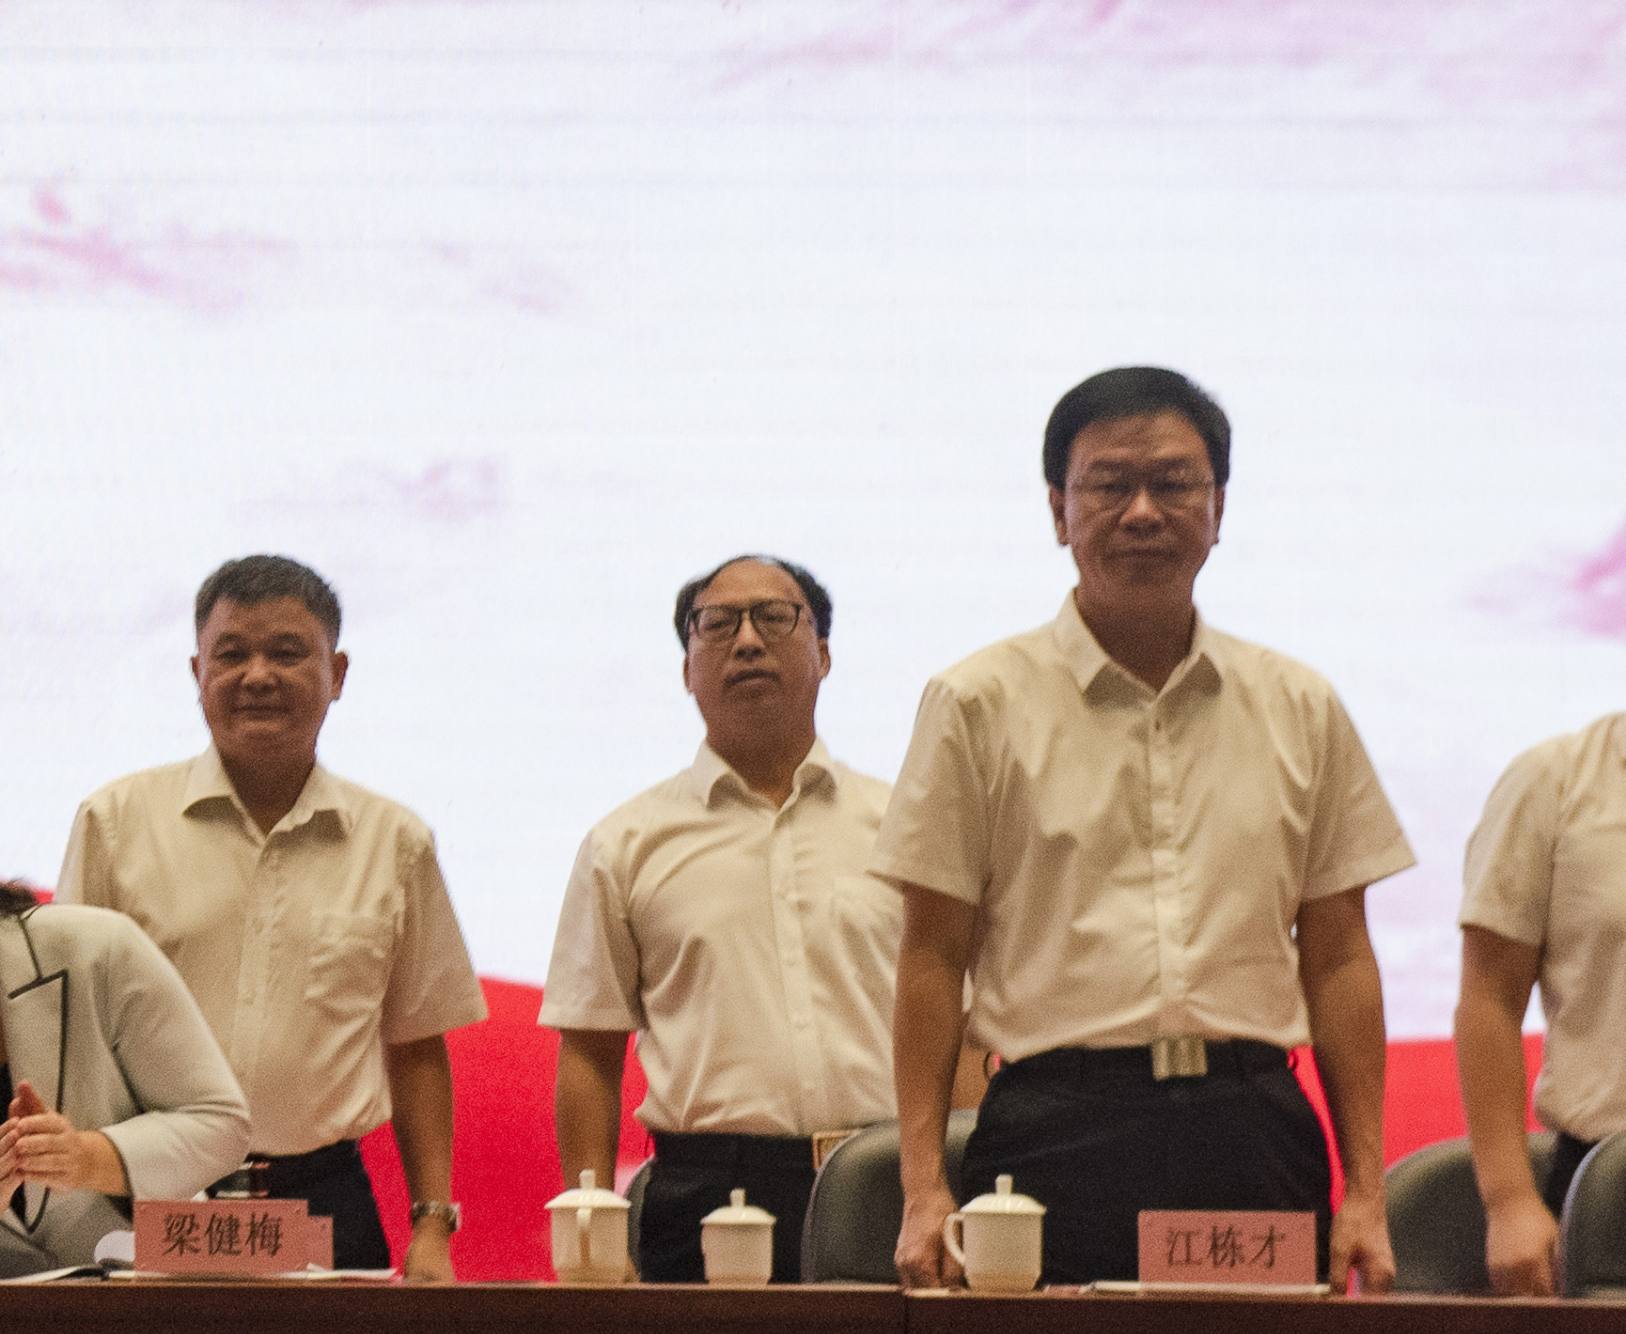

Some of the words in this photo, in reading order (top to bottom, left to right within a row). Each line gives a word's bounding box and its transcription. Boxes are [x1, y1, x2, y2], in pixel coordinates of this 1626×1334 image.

[161, 1211, 285, 1258] 梁健梅
[1166, 1224, 1289, 1269] 江栋才
